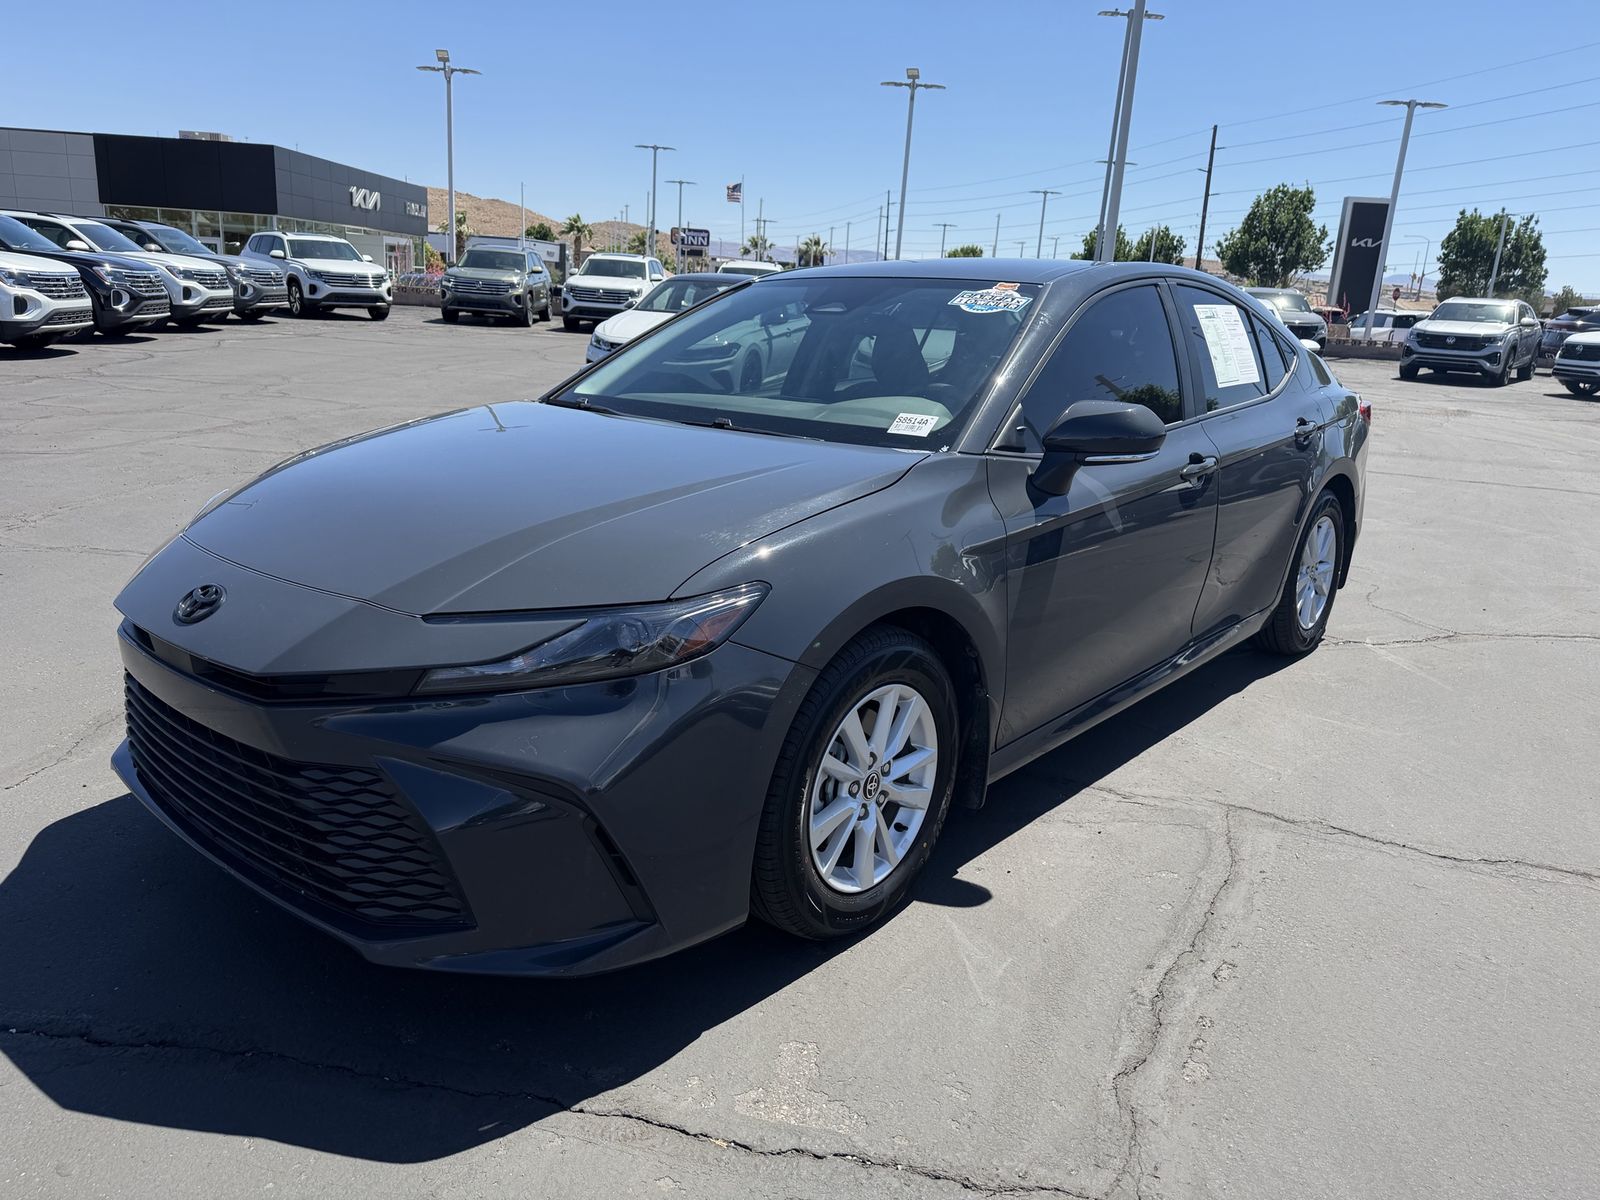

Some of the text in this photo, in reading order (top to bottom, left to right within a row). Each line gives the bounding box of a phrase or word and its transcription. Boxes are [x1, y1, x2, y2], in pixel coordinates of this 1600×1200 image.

[684, 235, 708, 246] INN
[960, 293, 1025, 304] CARFAX
[896, 416, 928, 426] S8514A
